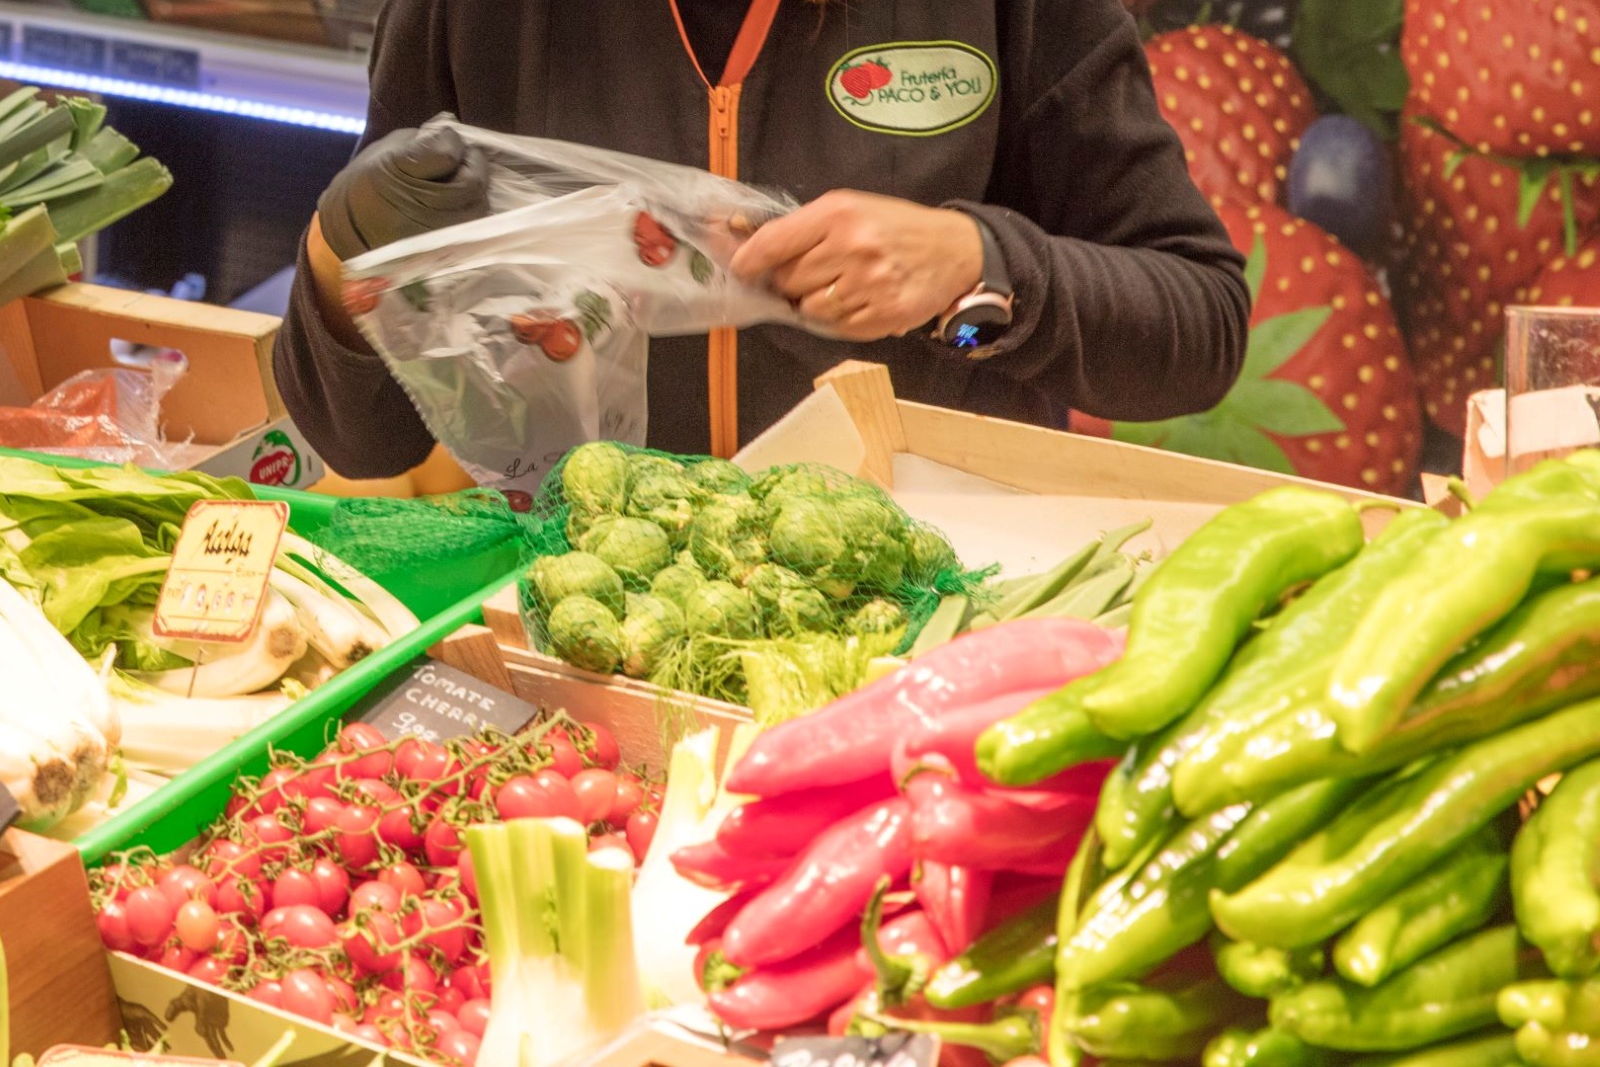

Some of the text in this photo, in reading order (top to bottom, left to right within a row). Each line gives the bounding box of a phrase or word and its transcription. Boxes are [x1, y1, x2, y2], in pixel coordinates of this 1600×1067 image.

[878, 87, 925, 103] PACO
[930, 86, 941, 101] &
[504, 457, 539, 480] La
[412, 664, 496, 712] TOMATE
